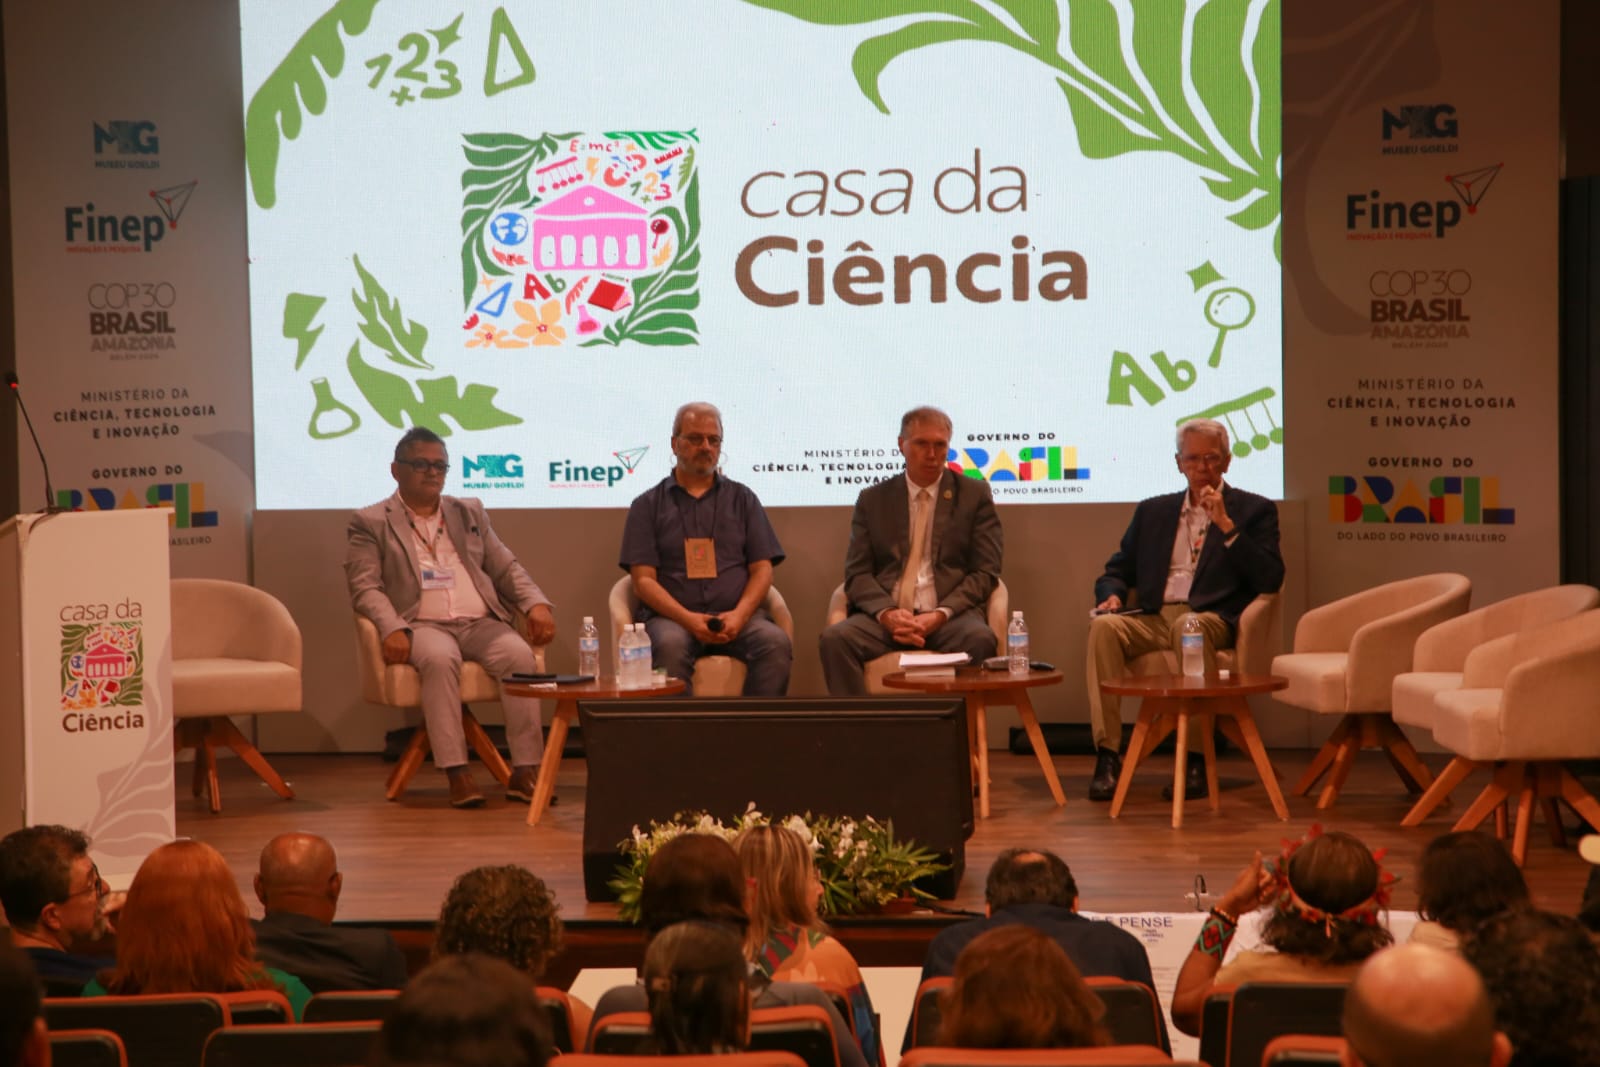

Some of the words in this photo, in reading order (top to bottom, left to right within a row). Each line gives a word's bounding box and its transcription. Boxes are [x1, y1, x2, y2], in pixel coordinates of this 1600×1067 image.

[740, 169, 913, 218] casa
[933, 147, 1027, 213] da
[1347, 189, 1461, 238] Finep
[65, 202, 165, 252] Finep
[734, 235, 1088, 307] Ciência
[1370, 299, 1471, 323] BRASIL
[89, 311, 176, 335] BRASIL
[1358, 377, 1455, 391] MINISTÉRIO
[1463, 377, 1485, 390] DA
[80, 388, 165, 403] MINISTÉRIO
[171, 387, 189, 399] DA
[1327, 396, 1400, 410] CIÊNCIA,
[1408, 397, 1517, 409] TECNOLOGIA
[53, 408, 120, 423] CIÊNCIA,
[124, 405, 216, 419] TECNOLOGIA
[1370, 416, 1379, 428] E
[1386, 414, 1471, 430] INOVAÇÃO
[92, 428, 101, 440] E
[106, 423, 180, 438] INOVAÇÃO
[967, 433, 1031, 442] GOVERNO
[1038, 432, 1056, 441] DO
[804, 448, 886, 459] MINISTÉRIO
[753, 462, 814, 473] CIÊNCIA,
[1368, 457, 1443, 469] GOVERNO
[1452, 457, 1475, 469] DO
[92, 466, 157, 479] GOVERNO
[164, 465, 183, 475] DO
[549, 460, 624, 487] Finep
[825, 476, 832, 485] E
[838, 475, 889, 485] INOVA
[1003, 487, 1029, 495] POVO
[1031, 485, 1084, 495] BRASILEIRO
[1328, 475, 1516, 525] BRASIL
[169, 535, 212, 546] ASILEIRO
[1337, 532, 1353, 541] DO
[1410, 532, 1440, 542] POVO
[1444, 533, 1507, 543] BRASILEIRO
[60, 603, 109, 622] casa
[115, 597, 142, 618] da
[62, 711, 144, 732] Ciência
[1119, 916, 1173, 928] PENSE
